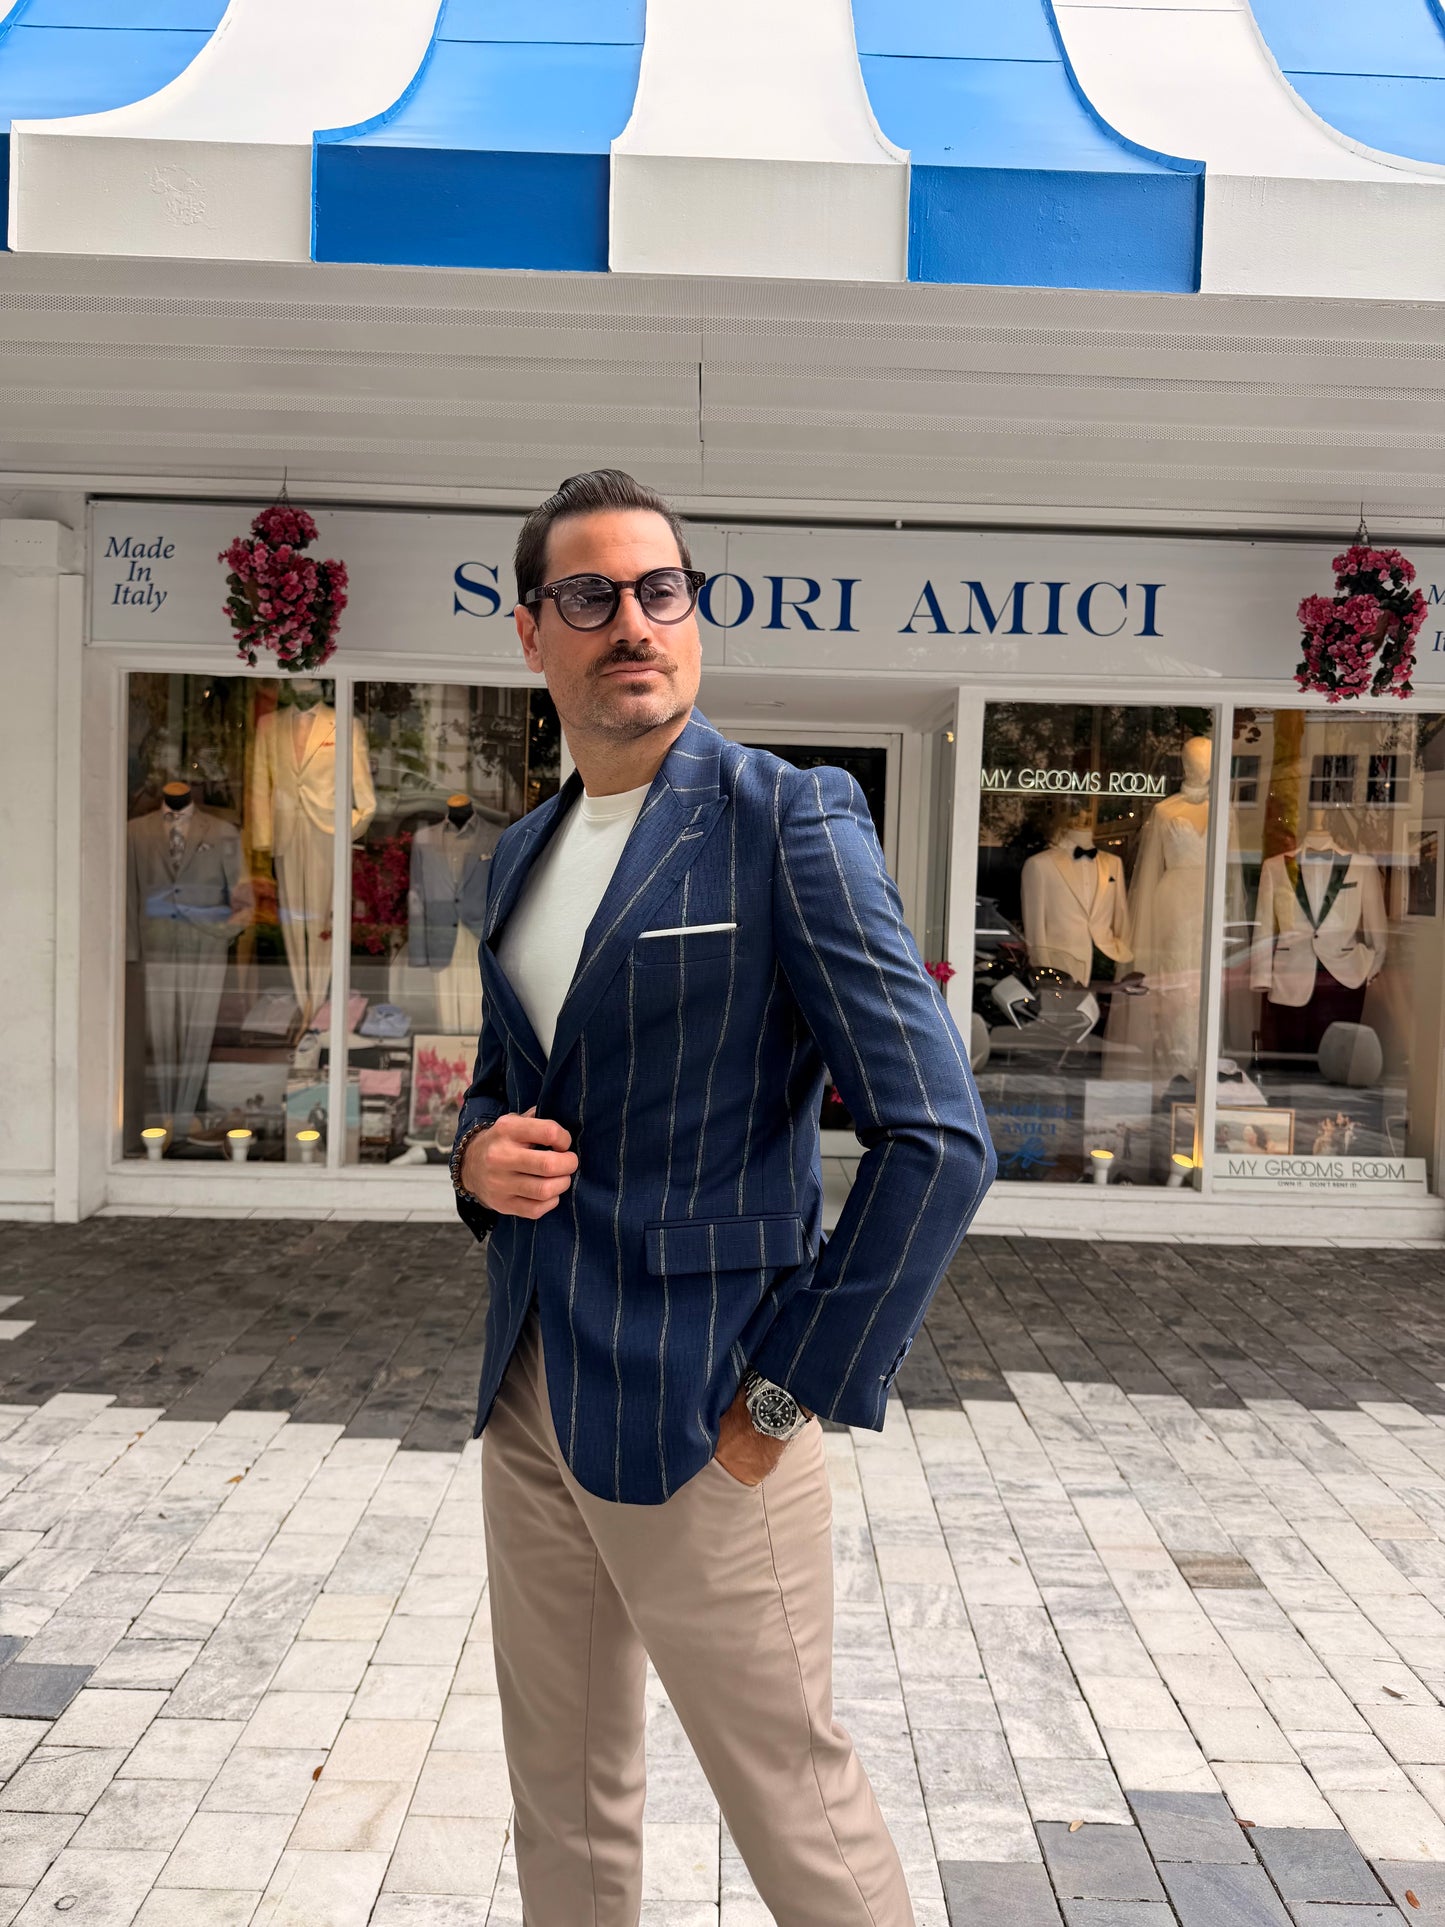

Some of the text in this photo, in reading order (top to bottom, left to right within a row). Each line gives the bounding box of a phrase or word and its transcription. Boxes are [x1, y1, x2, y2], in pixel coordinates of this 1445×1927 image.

[104, 536, 175, 558] Made
[126, 560, 152, 582] In
[111, 583, 168, 613] Italy
[453, 560, 1166, 637] SORI AMICI
[980, 768, 1166, 794] MY GROOMS ROOM
[1228, 1159, 1405, 1179] MY GROOMS ROOM
